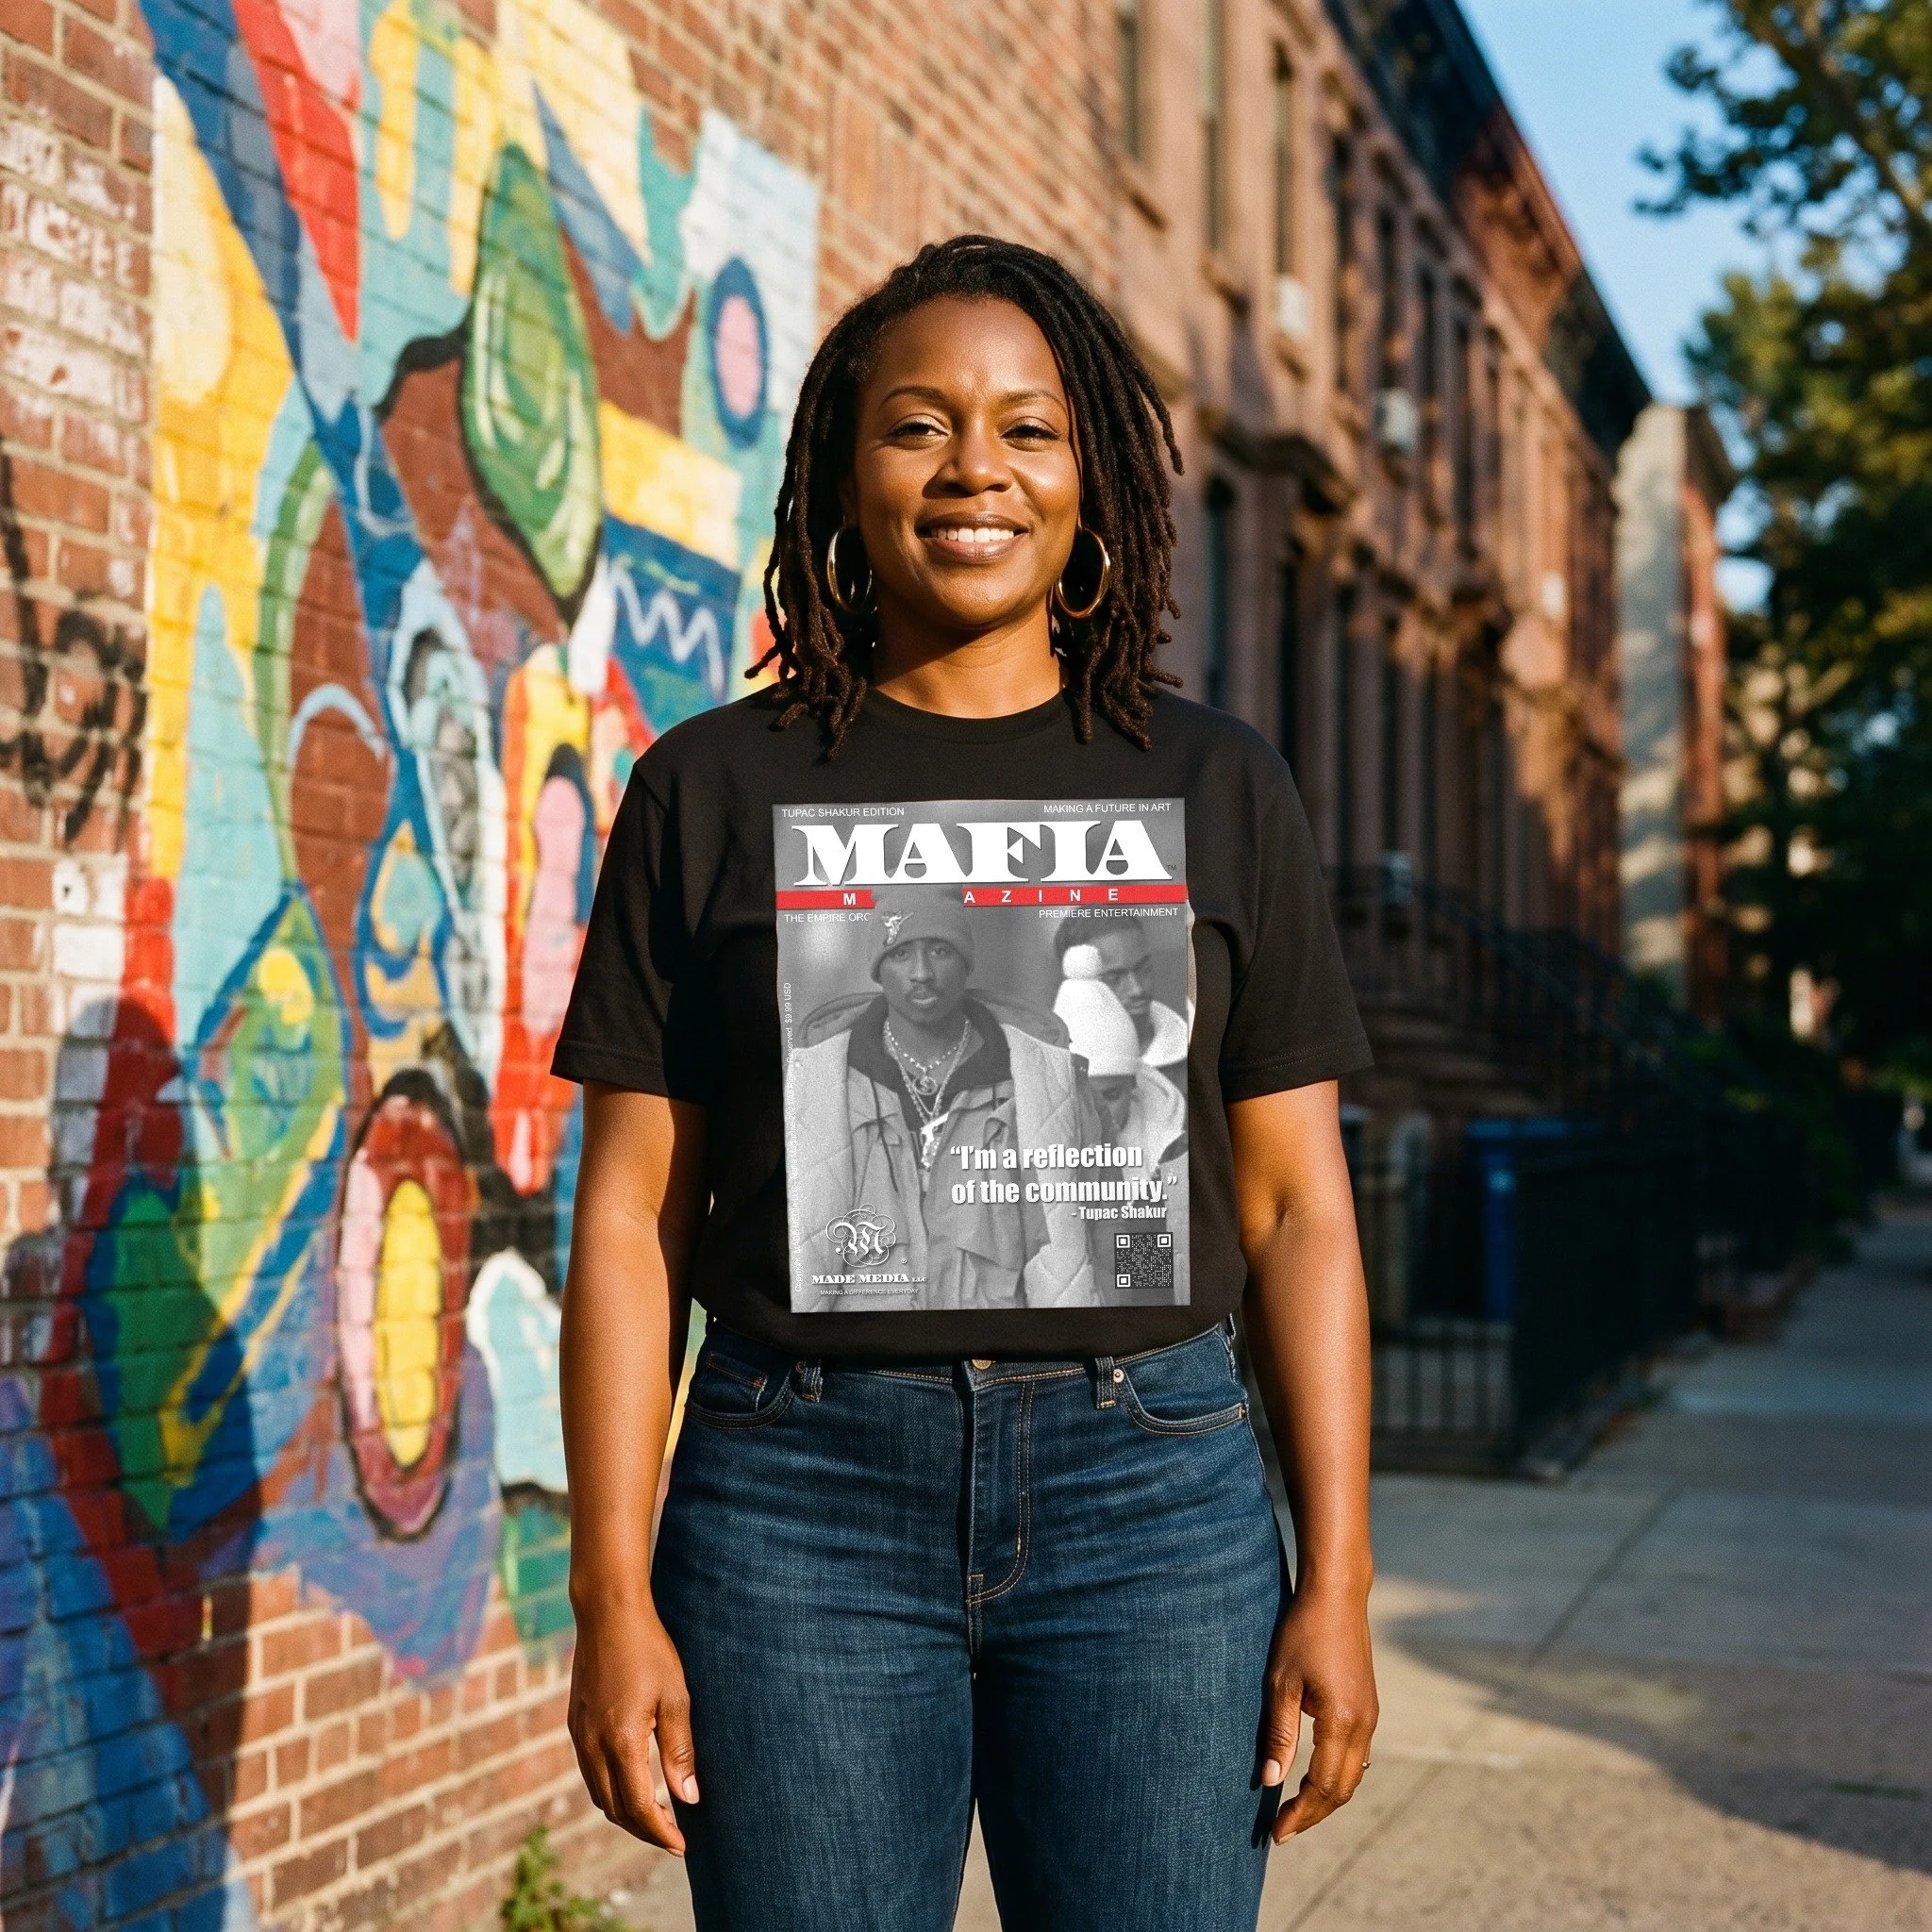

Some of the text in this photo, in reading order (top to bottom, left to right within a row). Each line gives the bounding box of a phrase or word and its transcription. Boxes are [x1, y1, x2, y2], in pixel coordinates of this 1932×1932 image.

[781, 807, 905, 817] TUPAC SHAKUR EDITION
[1043, 803, 1172, 813] MAKING A FUTURE IN ART
[791, 820, 1173, 886] MAFIA
[784, 913, 805, 923] THE
[807, 913, 845, 922] EMPIRE
[1039, 908, 1178, 918] PREMIERE ENTERTAINMENT
[783, 982, 791, 1001] USD
[784, 1002, 792, 1024] $9.99
[786, 1027, 794, 1063] Reserved
[1002, 1147, 1017, 1169] a
[1023, 1143, 1142, 1169] reflection
[791, 1186, 799, 1201] LLC
[951, 1176, 1177, 1204] of the community.”
[791, 1203, 800, 1228] MEDIA
[1078, 1206, 1119, 1221] Tupac
[1121, 1205, 1167, 1219] Shakur
[792, 1228, 801, 1254] MADE
[811, 1274, 856, 1284] MADE
[858, 1274, 909, 1283] MEDIA
